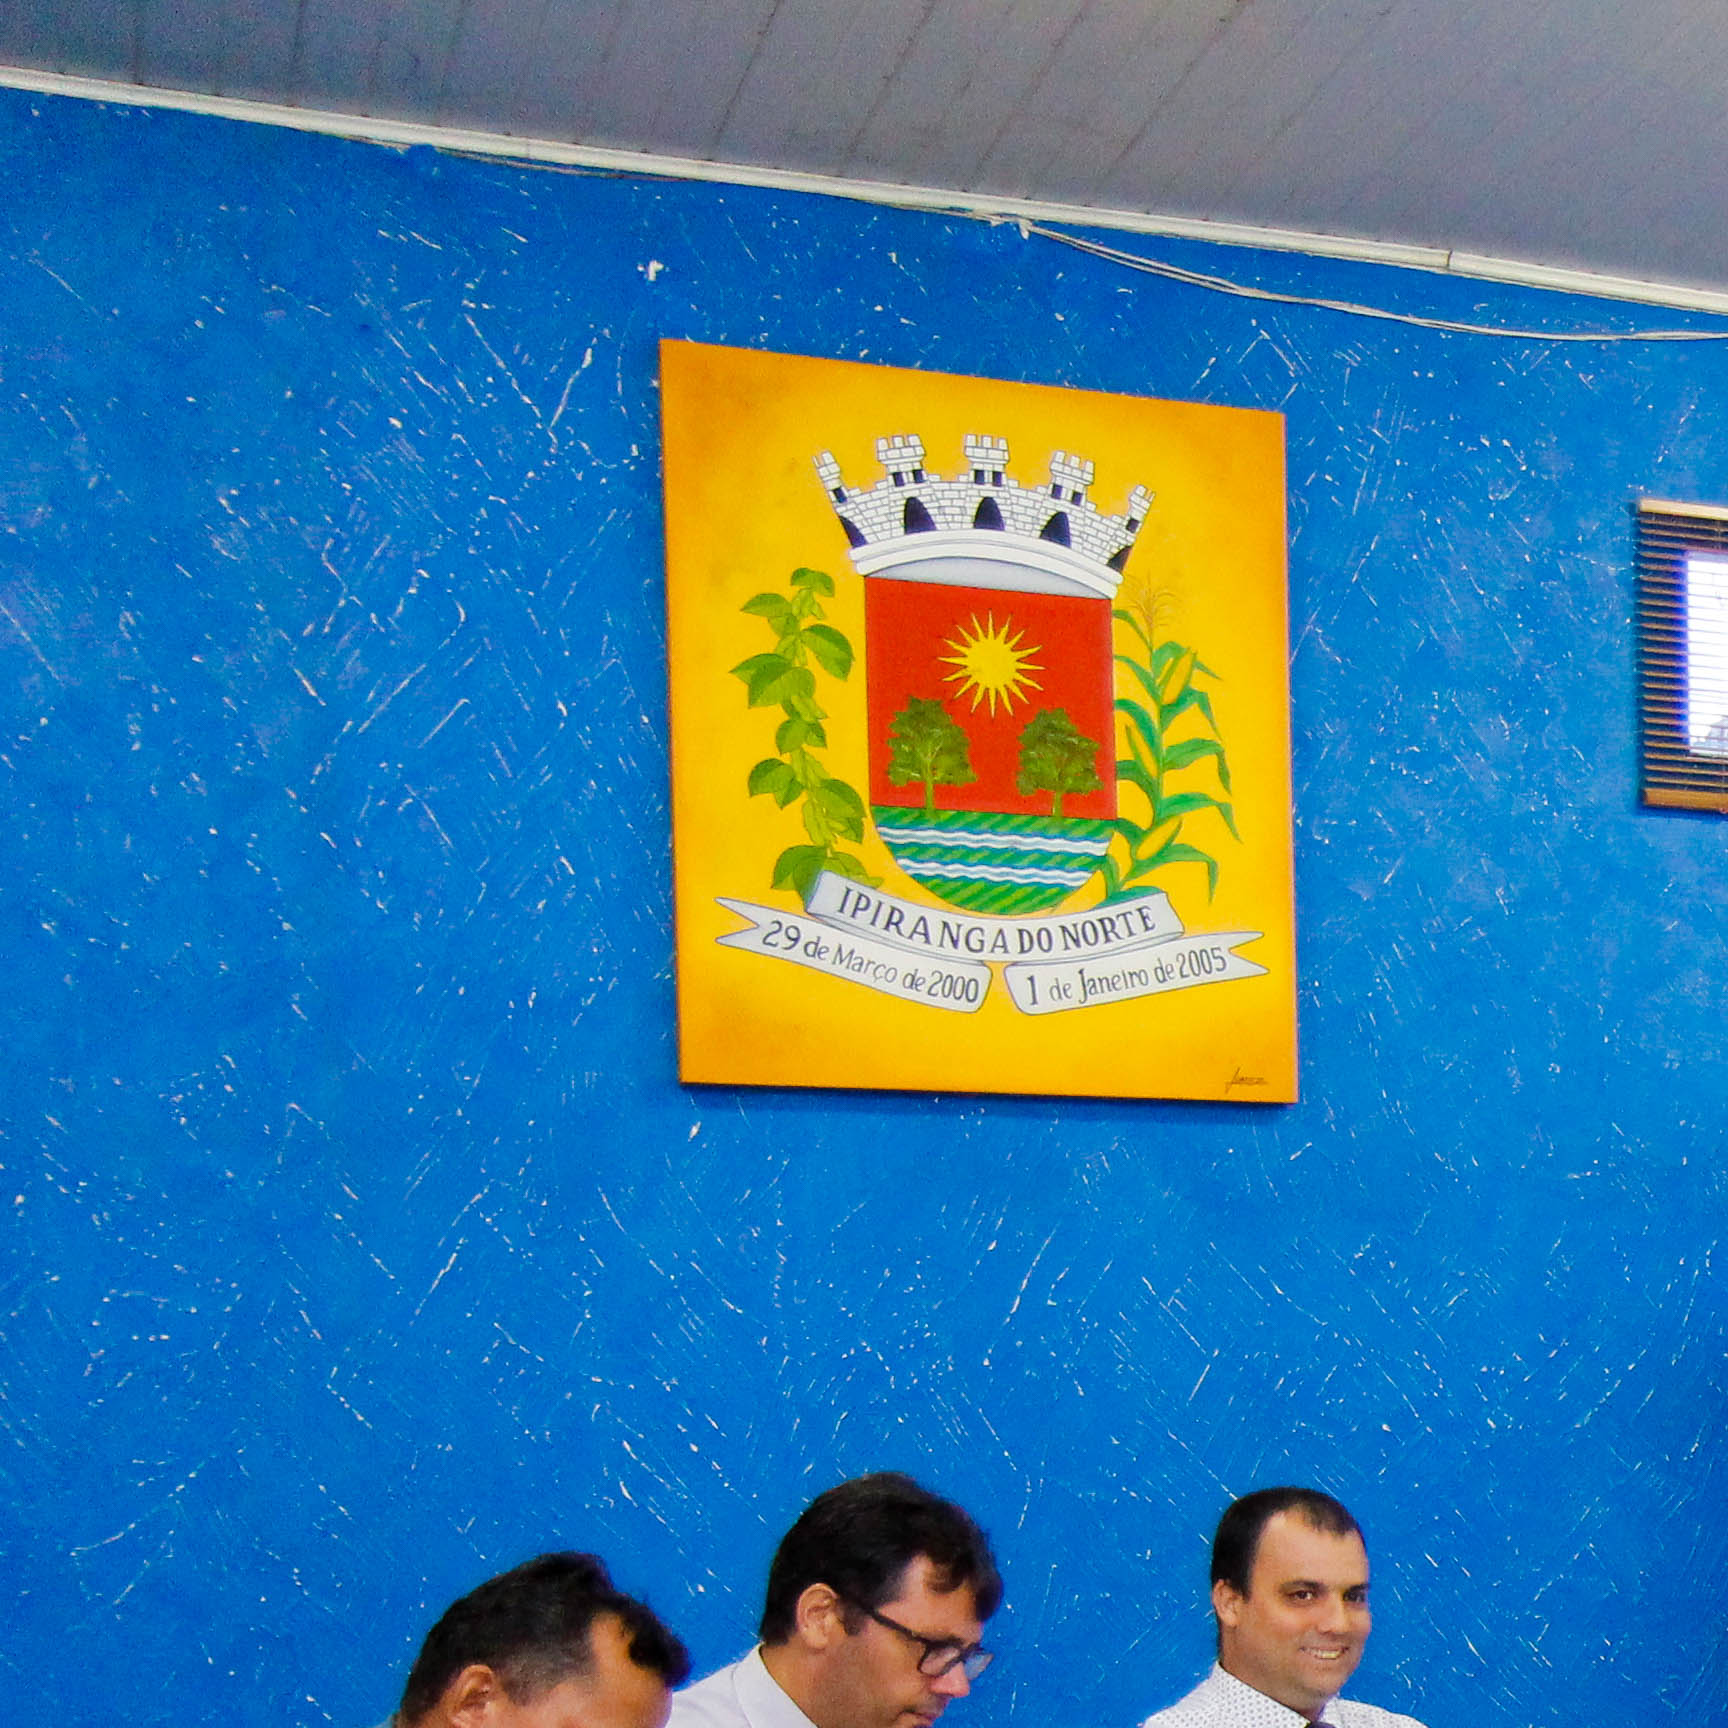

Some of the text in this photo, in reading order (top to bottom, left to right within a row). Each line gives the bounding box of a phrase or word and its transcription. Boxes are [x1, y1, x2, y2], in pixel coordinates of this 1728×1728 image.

[837, 886, 1156, 955] IPIRANGA DO NORTE
[762, 919, 979, 1005] 29 de Março de 2000
[1028, 946, 1228, 1006] 1 de Janeiro de 2005
